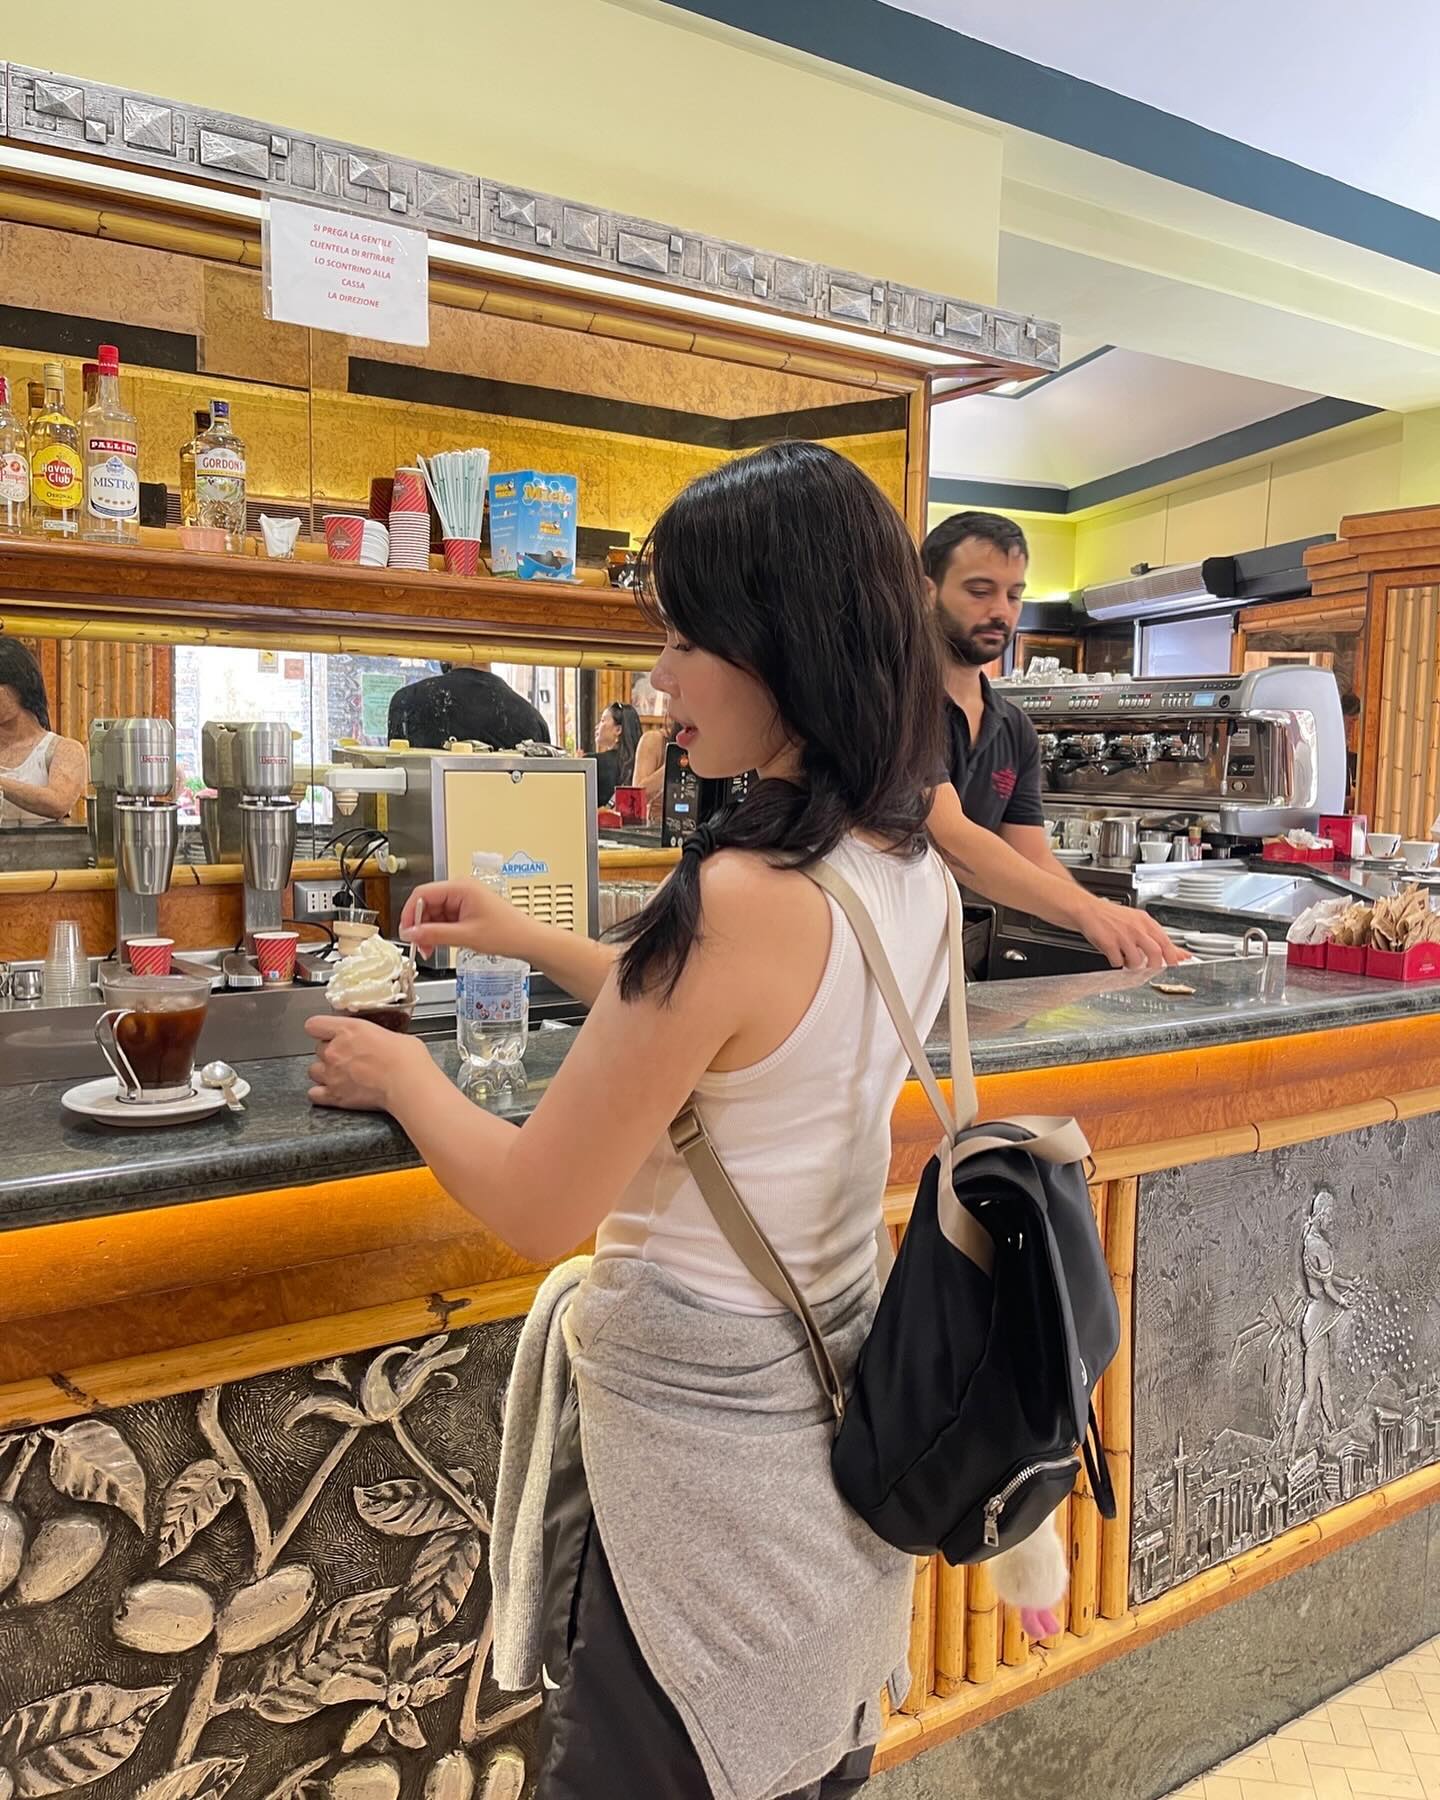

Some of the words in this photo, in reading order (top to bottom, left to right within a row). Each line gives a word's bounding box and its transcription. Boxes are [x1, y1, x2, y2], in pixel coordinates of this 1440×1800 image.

[313, 224, 321, 232] SI
[322, 226, 348, 238] PREGA
[350, 232, 360, 240] LA
[361, 235, 392, 248] GENTILE
[310, 240, 350, 255] CLIENTELA
[361, 251, 396, 264] RITIRARE
[314, 257, 325, 265] LO
[326, 260, 371, 275] SCONTRINO
[372, 270, 391, 280] ALLA
[341, 278, 366, 289] CASSA
[339, 294, 380, 308] DIREZIONE
[91, 441, 136, 453] PALLINI
[48, 472, 71, 484] Club
